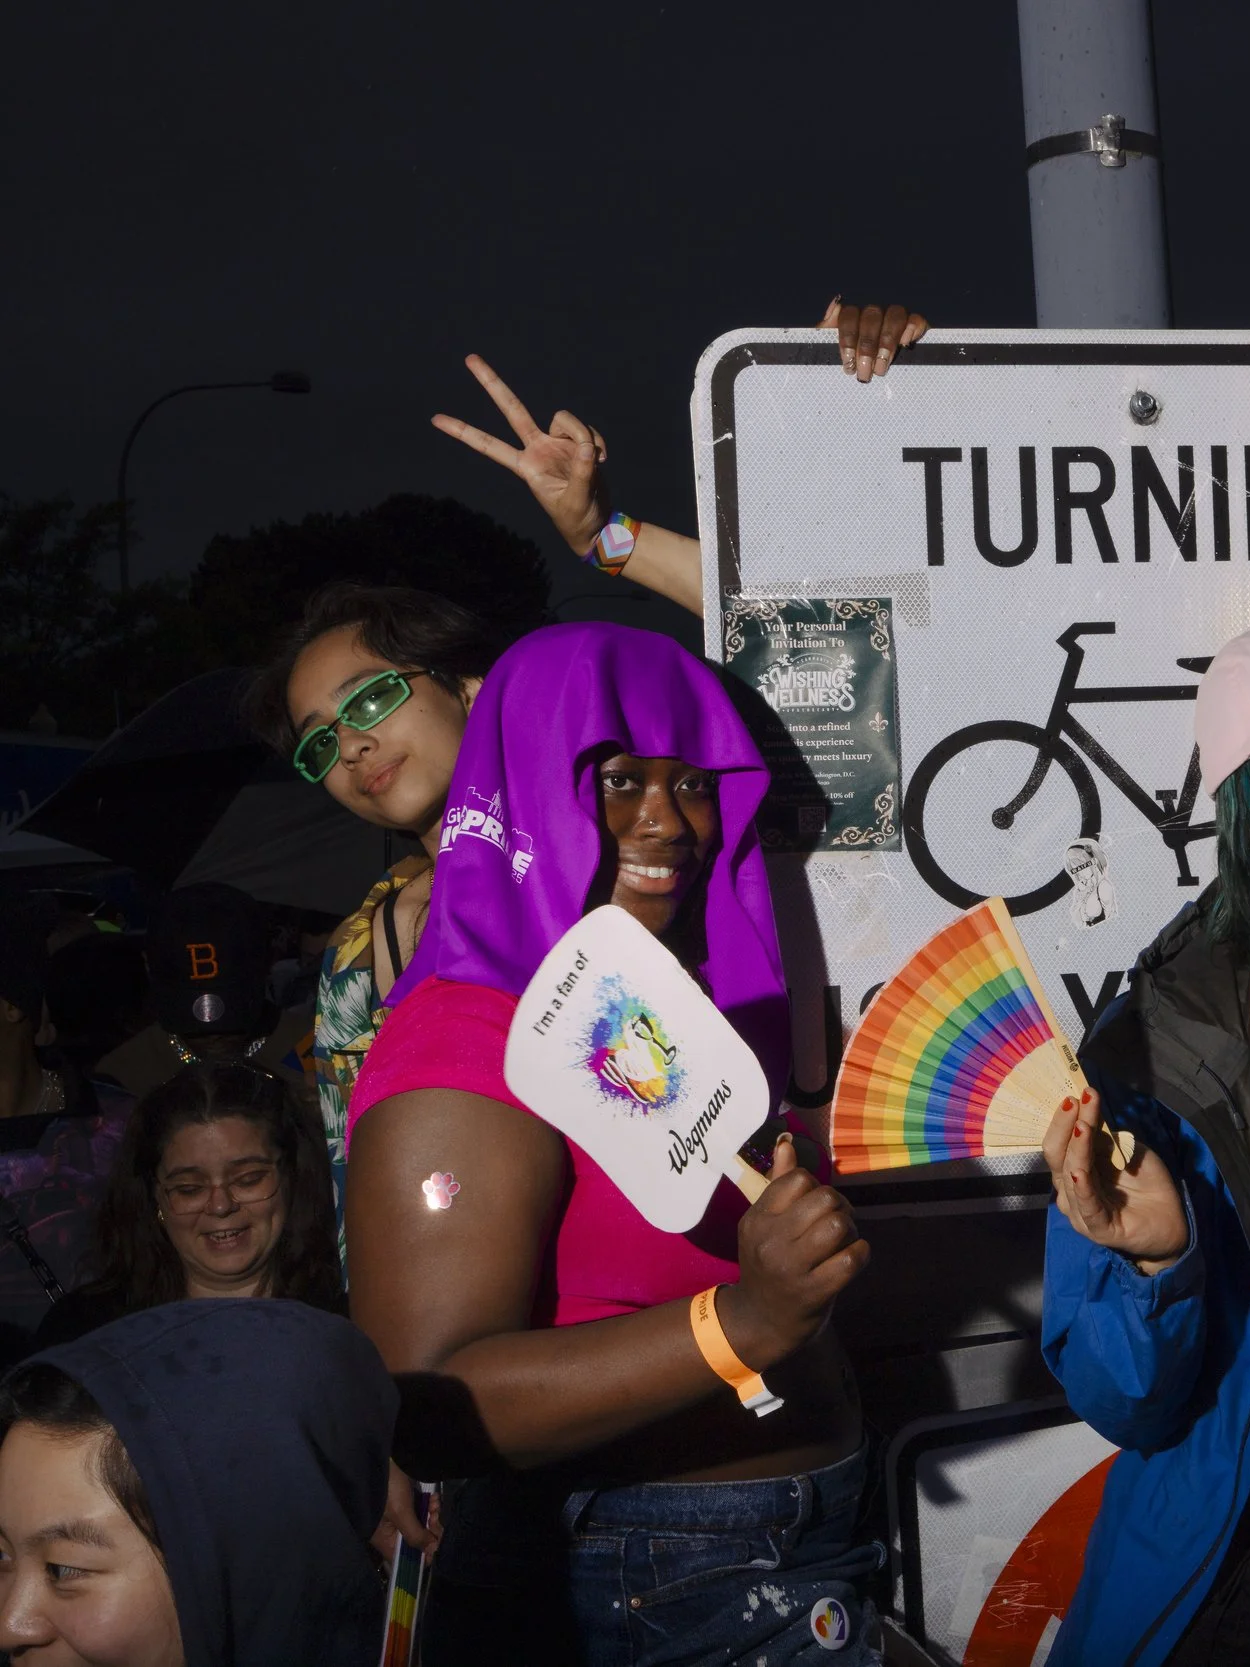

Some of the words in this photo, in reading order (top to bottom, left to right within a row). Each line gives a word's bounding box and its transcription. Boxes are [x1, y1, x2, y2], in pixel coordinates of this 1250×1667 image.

[765, 622, 793, 632] Your
[796, 621, 847, 632] Personal
[770, 638, 826, 649] Invitation
[829, 638, 845, 648] To
[769, 666, 848, 689] WISHING
[757, 682, 856, 712] WELLNESS
[789, 723, 809, 731] into
[818, 722, 851, 731] refined
[806, 738, 855, 748] experience
[842, 752, 873, 763] luxury
[844, 791, 855, 799] off
[184, 943, 219, 980] B
[575, 949, 589, 971] of
[555, 971, 580, 998] fan
[551, 998, 563, 1010] a
[532, 1010, 556, 1036] I'm
[668, 1079, 732, 1175] Wegmans
